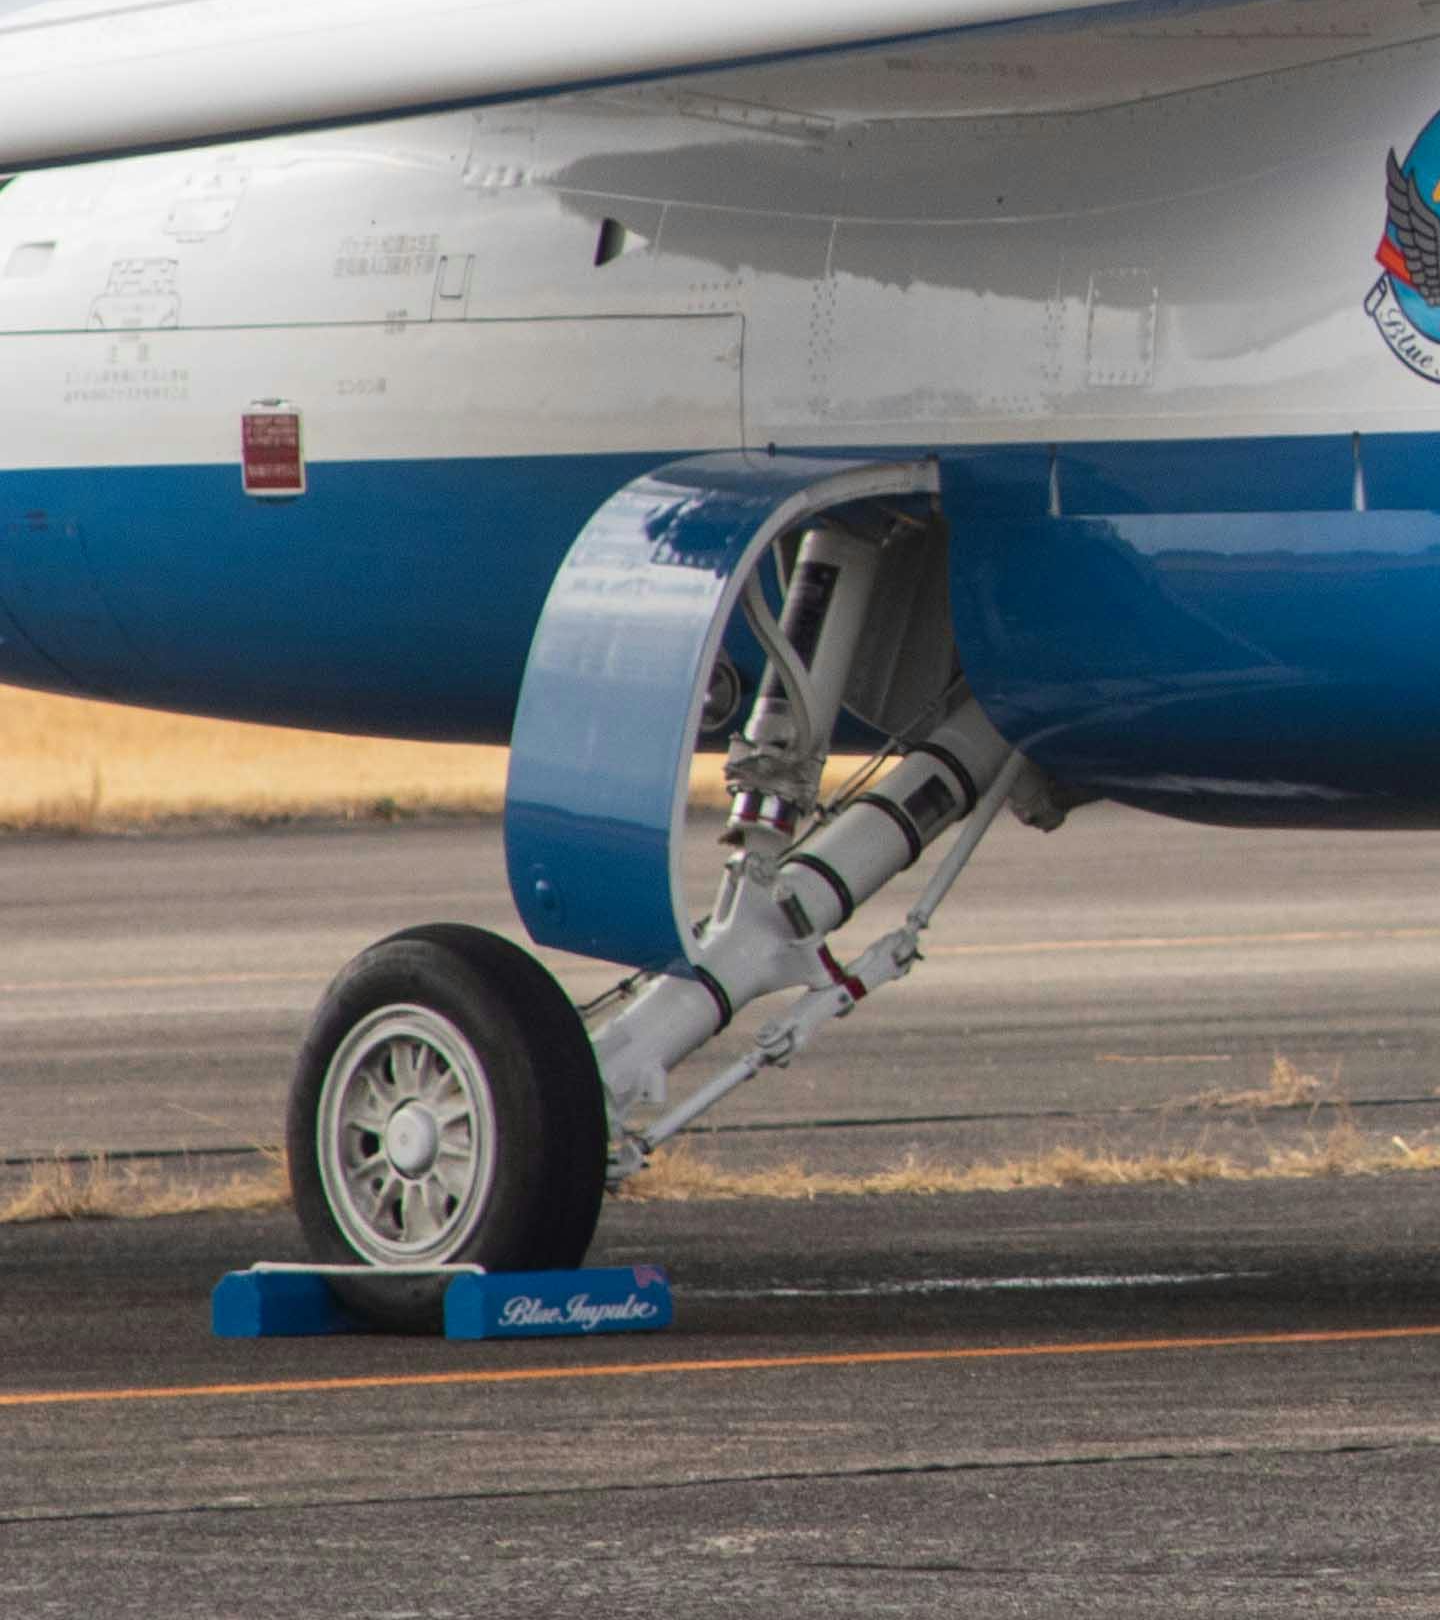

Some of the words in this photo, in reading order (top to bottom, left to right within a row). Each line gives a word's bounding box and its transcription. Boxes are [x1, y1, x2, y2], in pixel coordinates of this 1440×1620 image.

[1379, 306, 1434, 369] Blue
[498, 1295, 563, 1327] Blue
[560, 1292, 660, 1331] Impulse
